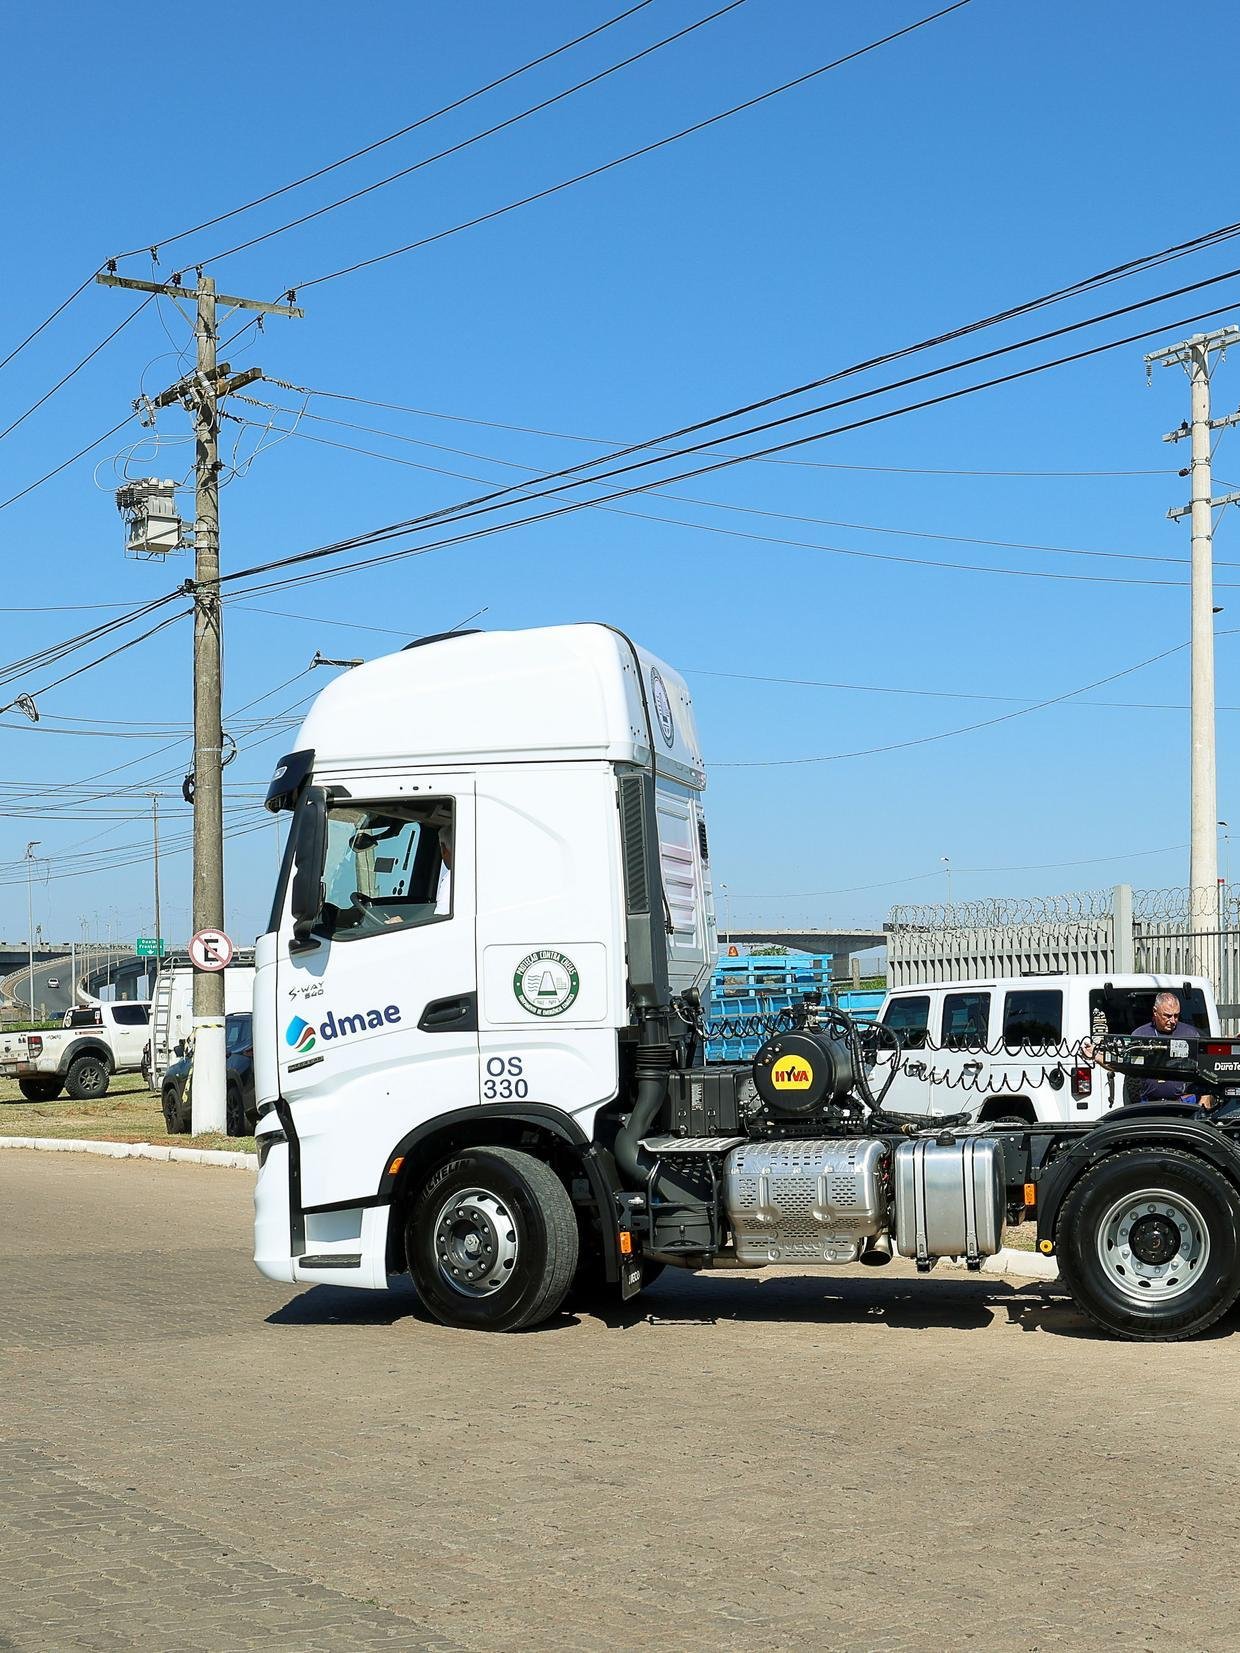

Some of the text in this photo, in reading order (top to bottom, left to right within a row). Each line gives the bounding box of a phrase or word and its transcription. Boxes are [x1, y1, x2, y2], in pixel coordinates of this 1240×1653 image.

[204, 939, 218, 961] E
[319, 1005, 401, 1041] dmae
[486, 1056, 523, 1077] OS
[775, 1066, 809, 1082] HYVA
[484, 1078, 528, 1099] 330
